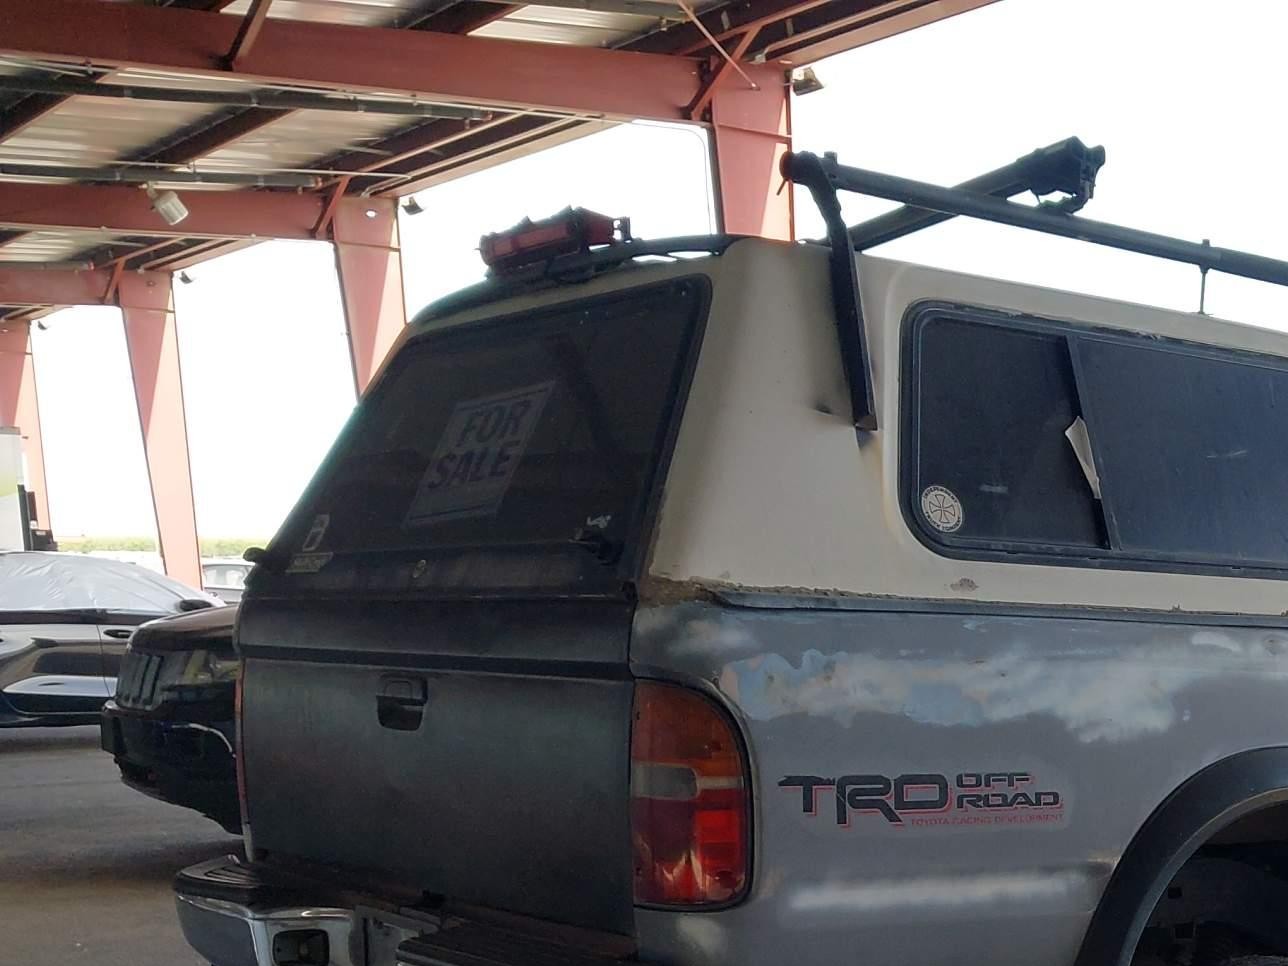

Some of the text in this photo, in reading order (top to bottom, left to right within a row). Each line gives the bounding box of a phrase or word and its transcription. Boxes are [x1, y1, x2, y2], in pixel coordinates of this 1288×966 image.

[456, 400, 528, 447] FOR
[430, 446, 516, 489] SALE
[956, 772, 1033, 789] OFF
[778, 773, 950, 827] TRD
[956, 791, 1062, 809] ROAD
[911, 813, 1064, 827] TOYOTA RACING DEVELOPMENT
